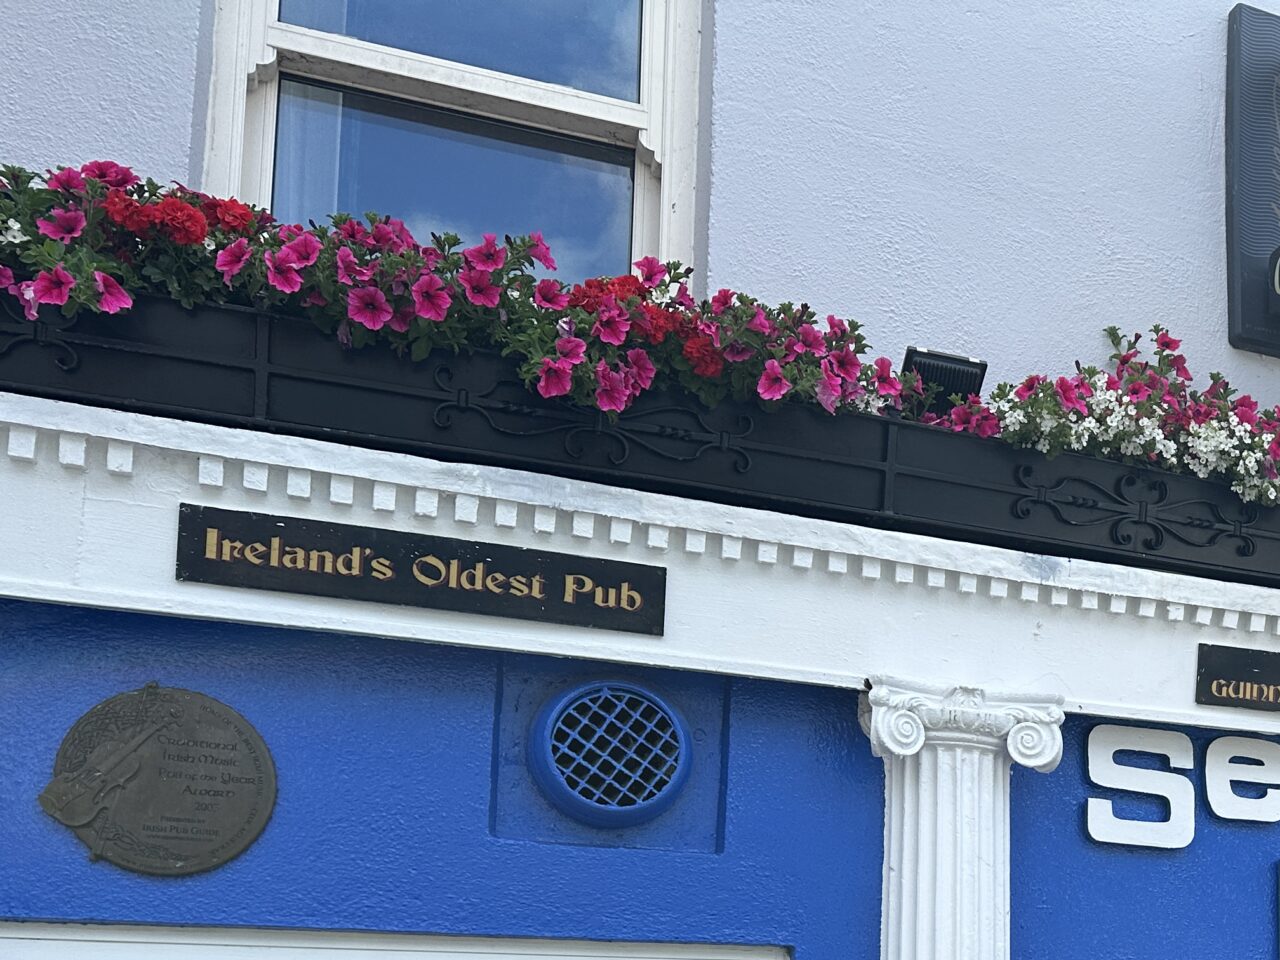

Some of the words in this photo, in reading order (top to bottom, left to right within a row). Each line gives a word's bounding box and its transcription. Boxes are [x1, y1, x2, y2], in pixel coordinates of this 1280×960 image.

[203, 526, 396, 581] Ireland's
[411, 553, 546, 600] Oldest
[563, 573, 643, 612] Pub
